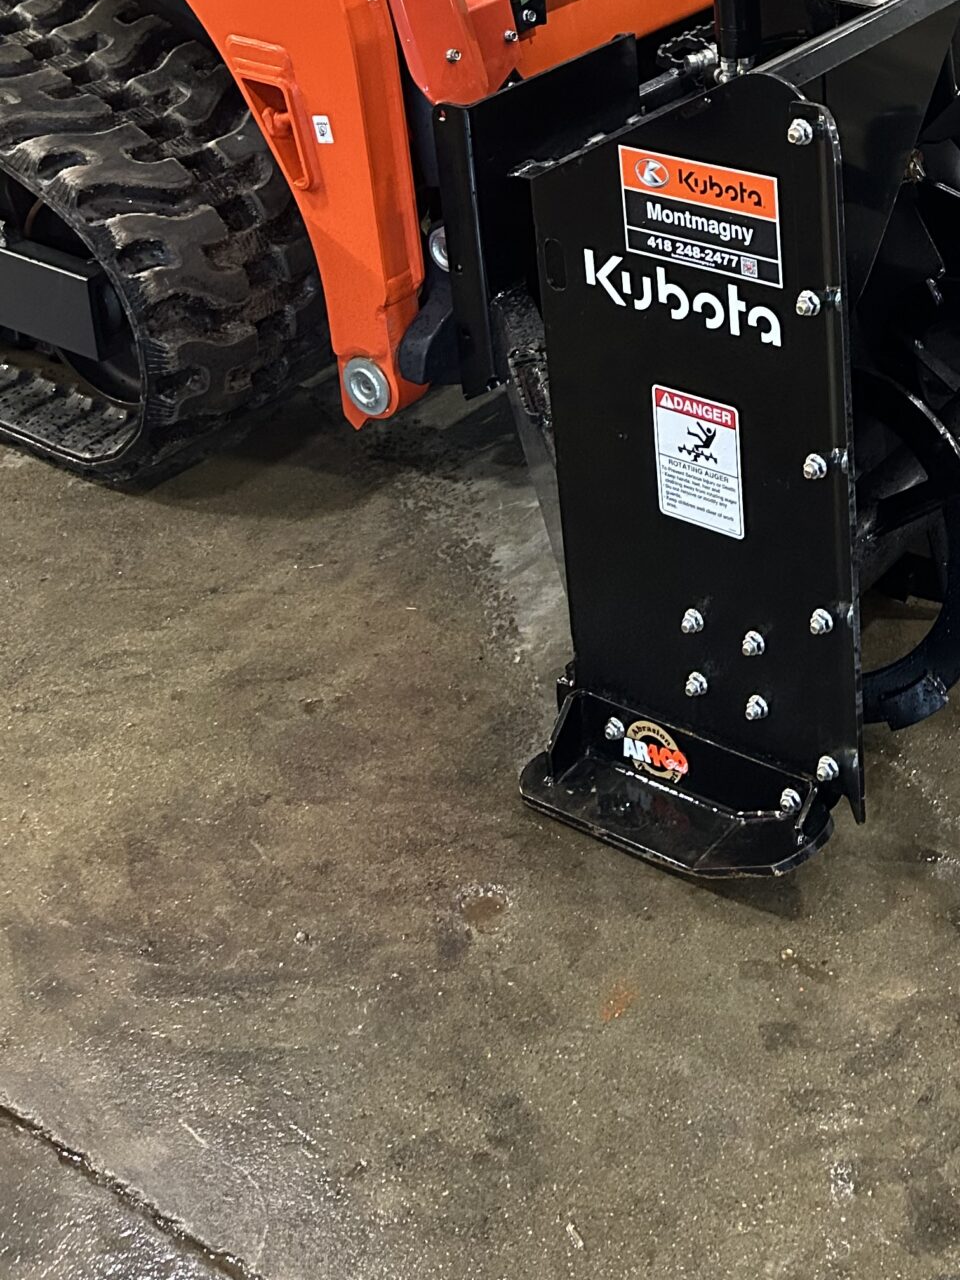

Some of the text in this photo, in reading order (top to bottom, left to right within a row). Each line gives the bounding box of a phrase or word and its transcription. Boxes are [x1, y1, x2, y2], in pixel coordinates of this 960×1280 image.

[677, 168, 763, 207] Kubota
[646, 201, 754, 246] Montmagny
[647, 236, 672, 252] 418
[675, 242, 738, 267] 248-2477
[583, 248, 782, 347] Kubota
[673, 396, 732, 425] DANGER
[668, 459, 729, 483] ROTATING AUGER
[631, 724, 671, 748] Abrasion
